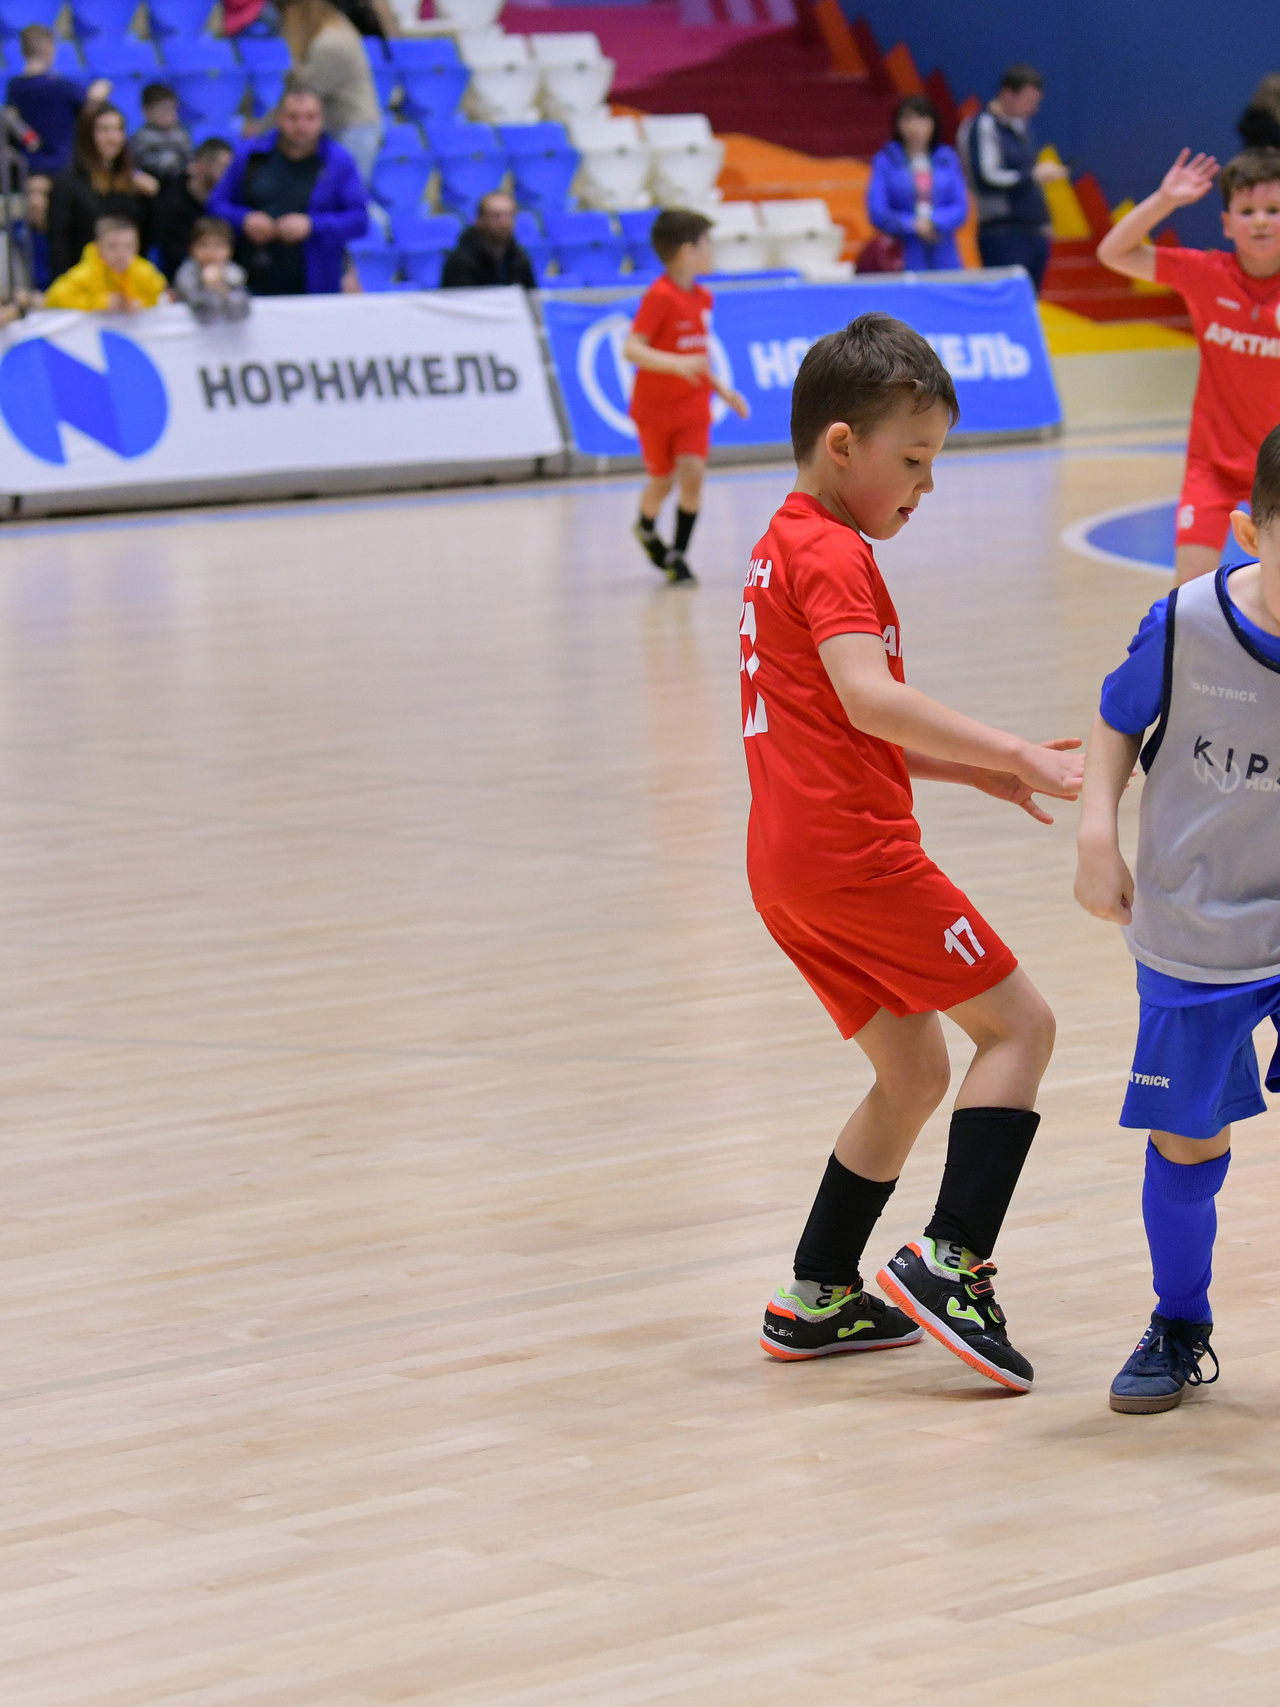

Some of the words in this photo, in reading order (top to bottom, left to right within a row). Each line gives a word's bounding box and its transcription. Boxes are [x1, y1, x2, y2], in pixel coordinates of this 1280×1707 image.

[200, 353, 518, 411] НОРНИКЕЛЬ
[1201, 683, 1258, 703] PATRICK
[943, 914, 986, 967] 17
